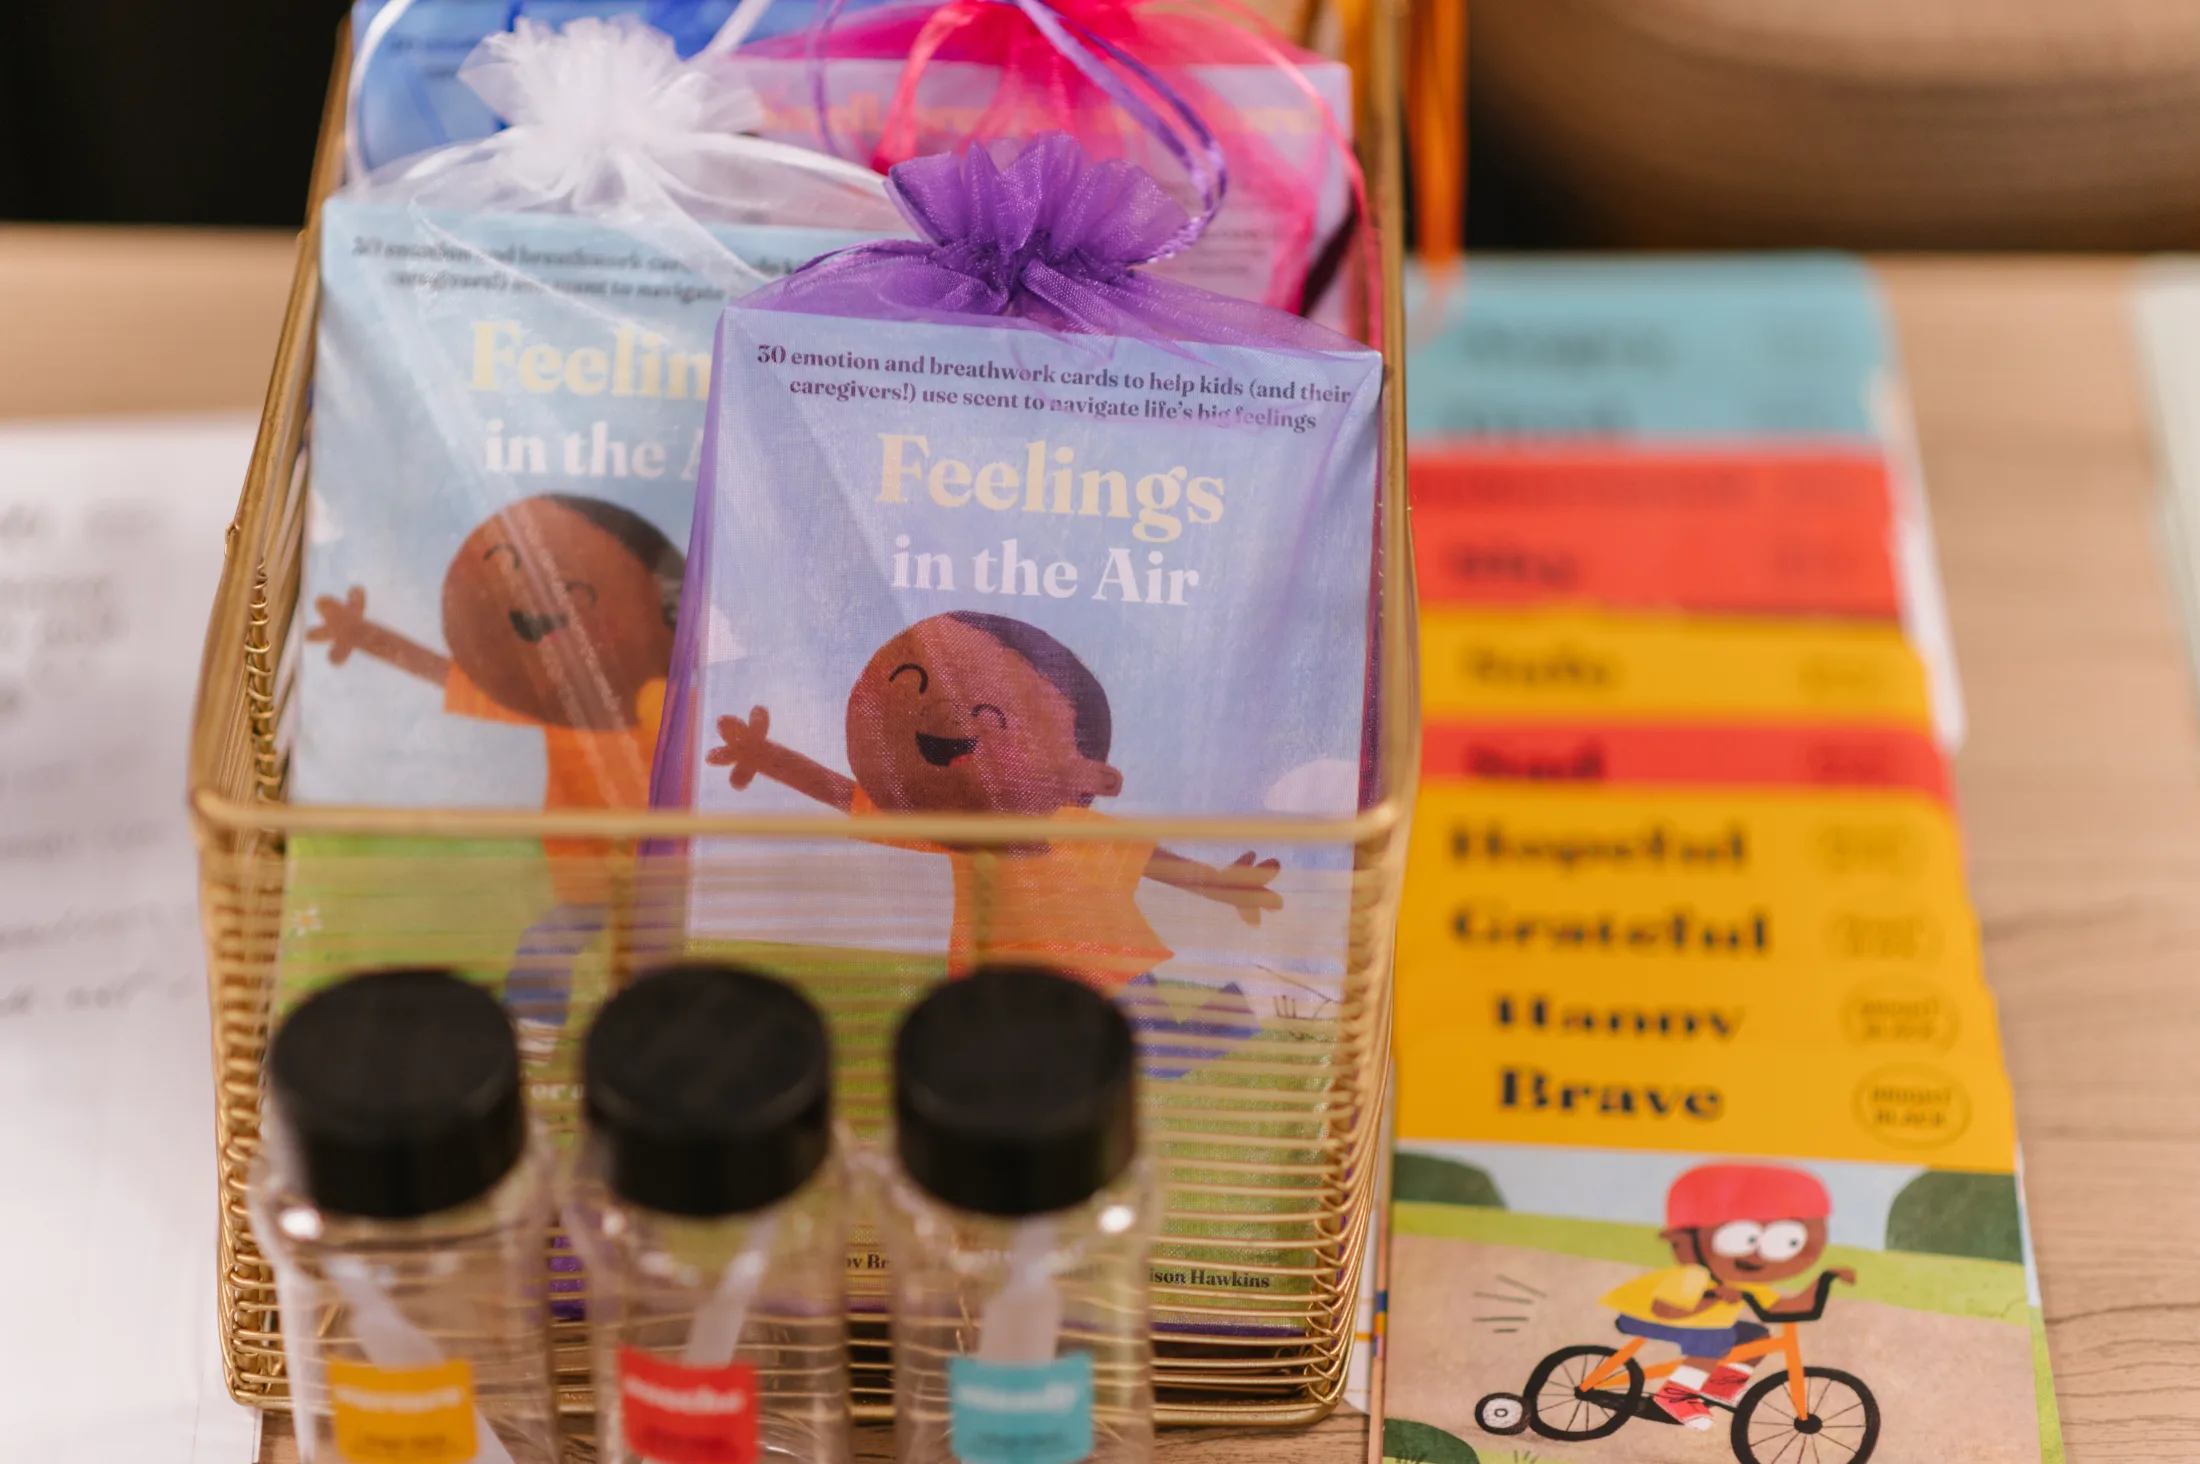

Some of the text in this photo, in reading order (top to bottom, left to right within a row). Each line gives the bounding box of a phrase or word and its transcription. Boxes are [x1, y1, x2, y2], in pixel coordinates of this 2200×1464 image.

[468, 320, 712, 399] Feelin
[757, 345, 1352, 404] 30 emotion and breathwork cards to help kids (and their
[790, 379, 917, 403] caregivers!)
[922, 391, 958, 405] use
[962, 391, 1018, 409] scent
[1024, 394, 1045, 412] to
[1049, 396, 1140, 419] navigate
[1144, 399, 1193, 420] life’s
[1235, 406, 1317, 433] feelings
[485, 418, 547, 475] in
[563, 420, 667, 480] the
[875, 433, 1225, 543] Feelings
[891, 535, 1199, 606] in the Air
[1499, 1068, 1724, 1122] Brave
[1148, 1267, 1186, 1284] ison
[1190, 1269, 1270, 1288] Hawkins
